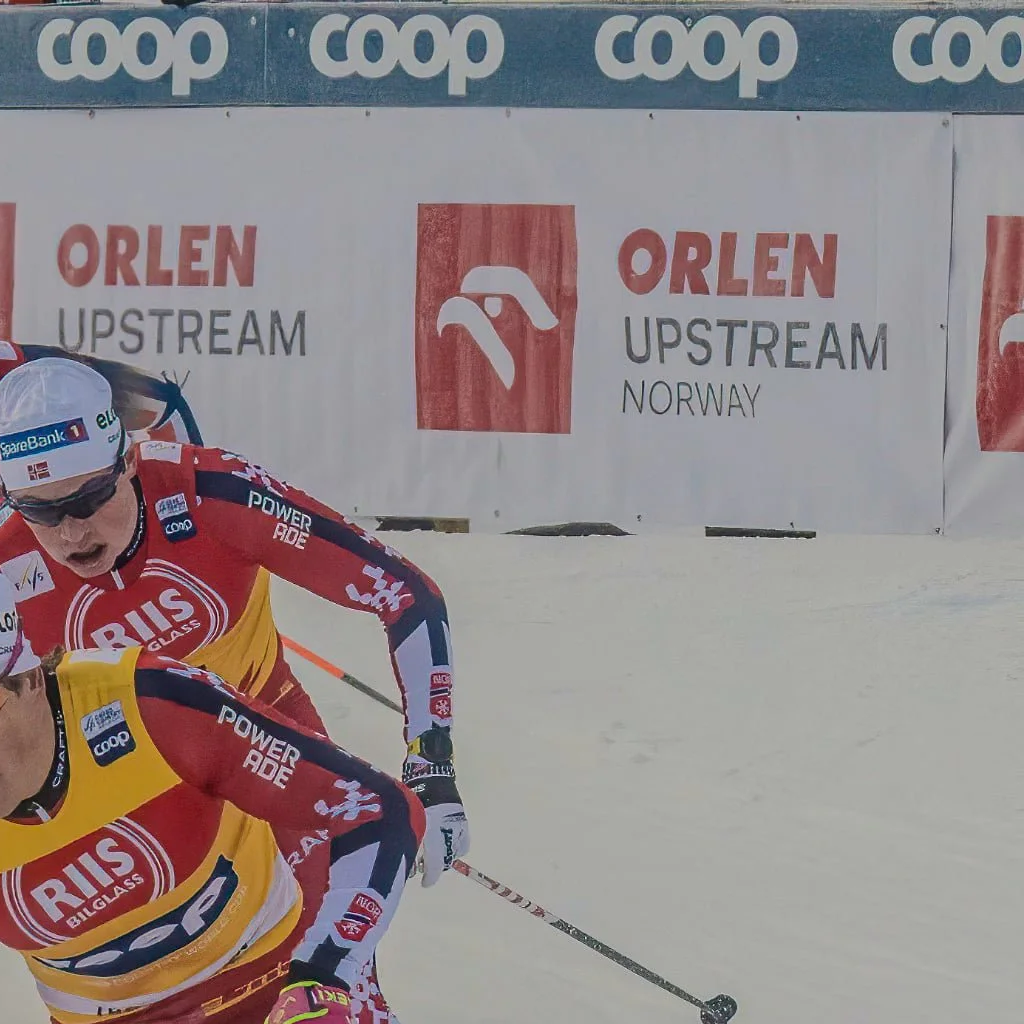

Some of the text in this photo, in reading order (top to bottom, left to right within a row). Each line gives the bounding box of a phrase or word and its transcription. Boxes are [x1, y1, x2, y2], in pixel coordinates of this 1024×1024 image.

[37, 16, 229, 96] coop
[309, 14, 505, 95] coop
[596, 14, 798, 98] coop
[892, 15, 1024, 84] coo
[57, 223, 257, 287] ORLEN
[618, 228, 838, 298] ORLEN
[58, 306, 306, 356] UPSTREAM
[624, 316, 888, 371] UPSTREAM
[622, 380, 761, 418] NORWAY
[0, 429, 66, 458] SpareBank
[247, 490, 312, 532] POWER
[272, 521, 311, 550] ADE
[90, 588, 195, 649] RIIS
[147, 620, 201, 652] GLASS
[93, 731, 130, 756] coop
[217, 705, 301, 768] POWER
[242, 749, 295, 790] ADE
[30, 837, 135, 923] RIIS
[65, 873, 145, 929] BILGLASS
